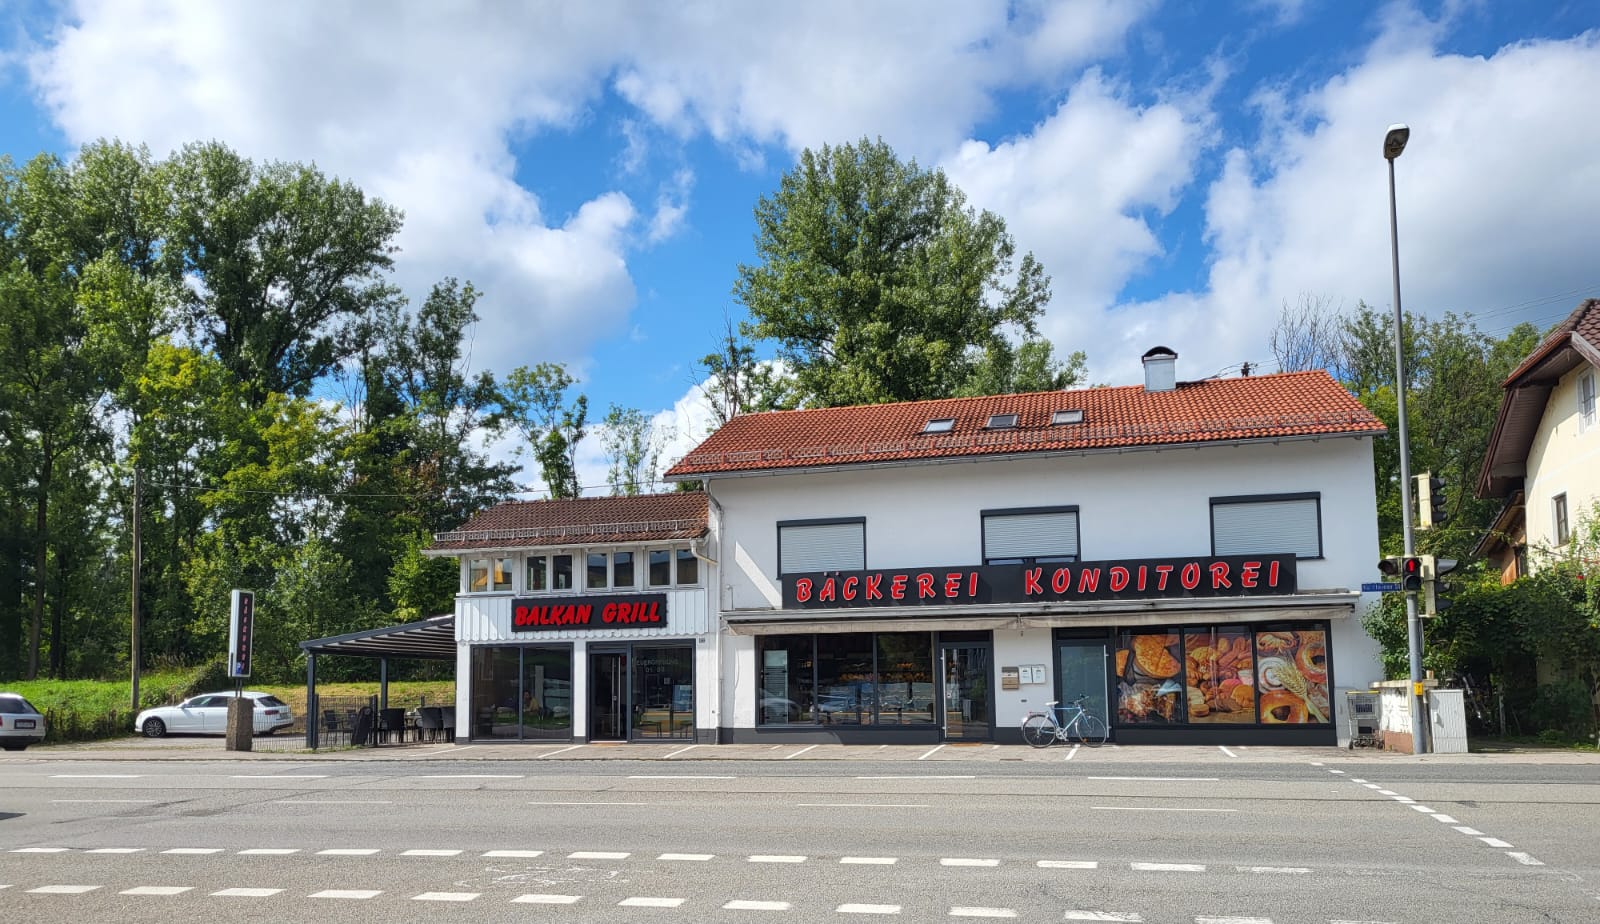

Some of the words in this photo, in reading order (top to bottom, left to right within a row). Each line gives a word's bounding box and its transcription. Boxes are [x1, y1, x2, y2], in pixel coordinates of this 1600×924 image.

[796, 571, 979, 602] BÄCKEREI
[1024, 560, 1280, 595] KONDITOREI
[514, 604, 593, 626] BALKAN
[601, 601, 661, 624] GRILL
